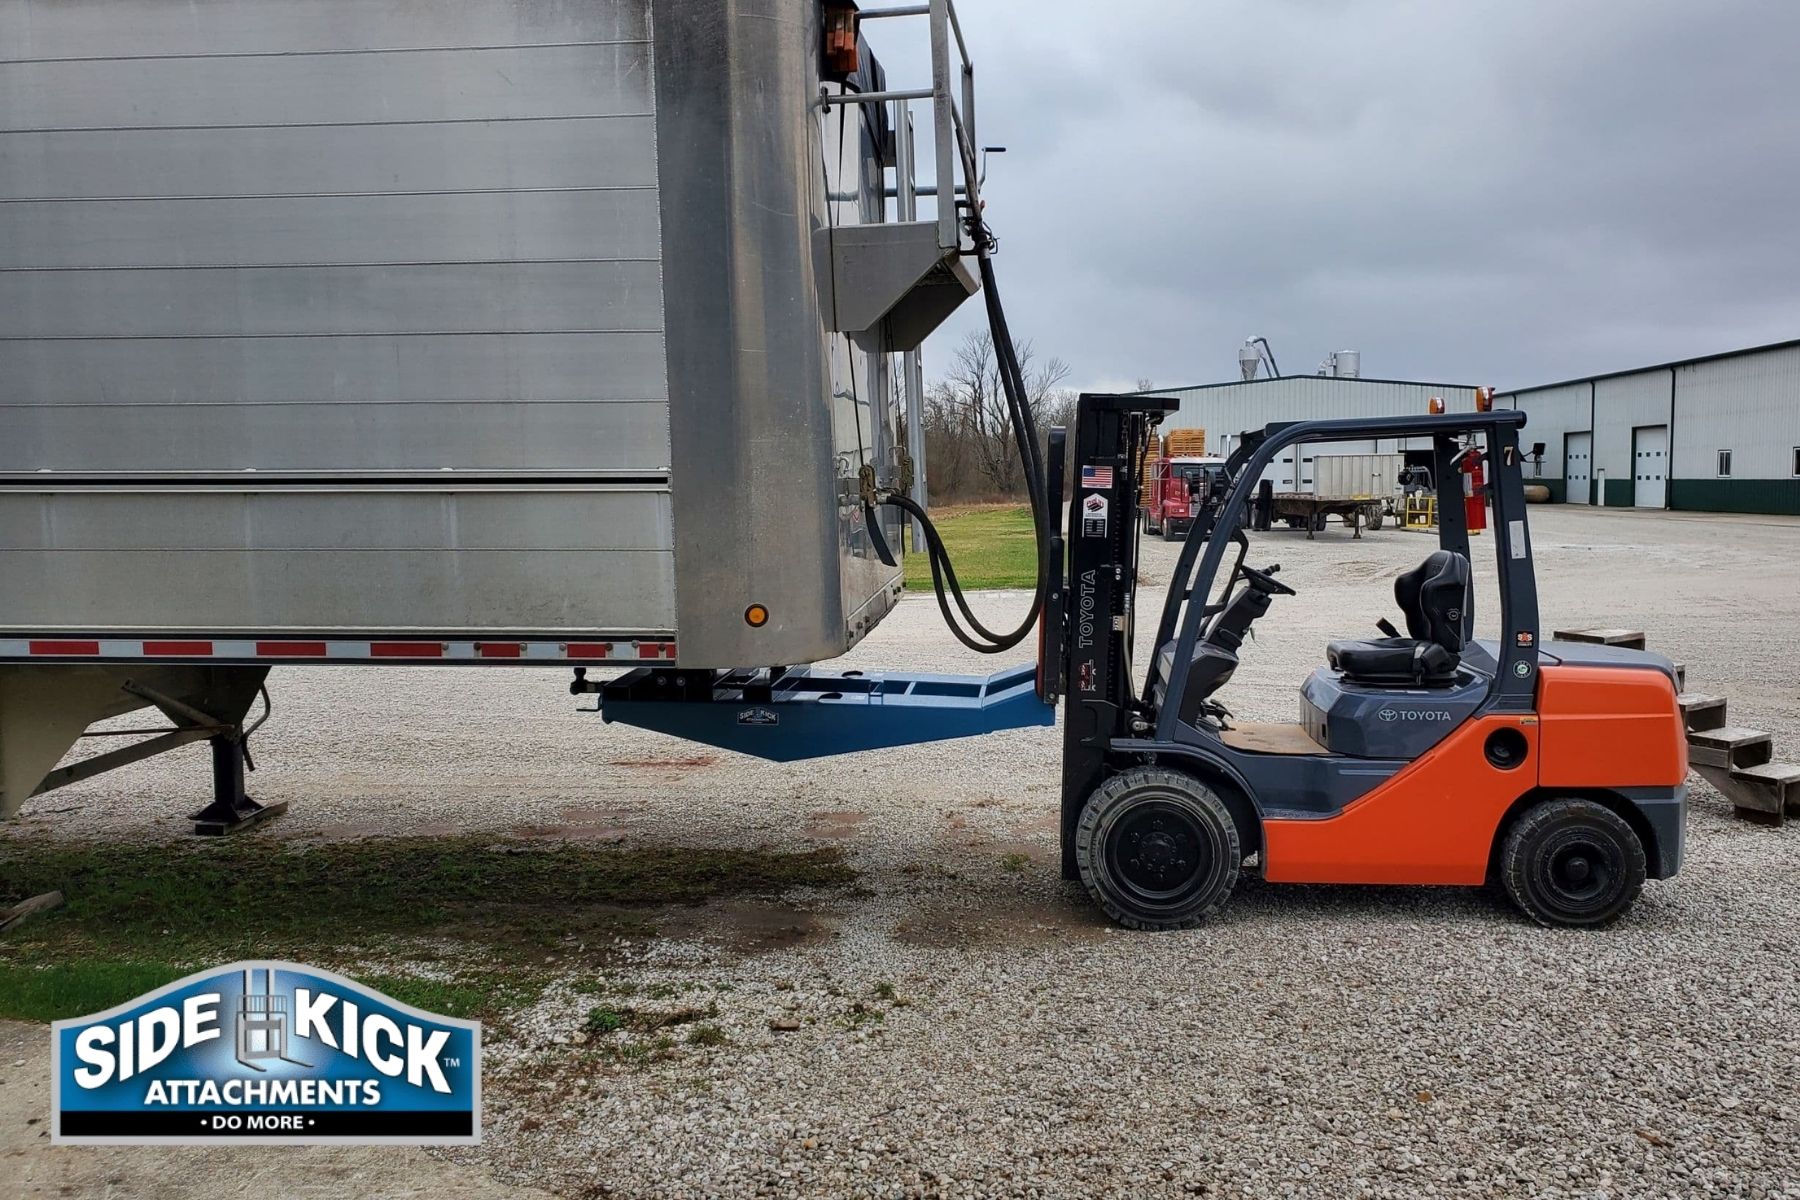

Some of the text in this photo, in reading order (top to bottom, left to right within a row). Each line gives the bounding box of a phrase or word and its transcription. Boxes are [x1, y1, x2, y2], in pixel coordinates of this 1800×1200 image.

[1503, 446, 1514, 466] 7
[1078, 569, 1096, 649] TOYOTA
[739, 710, 776, 720] SIDE KICK
[1400, 710, 1452, 721] TOYOTA
